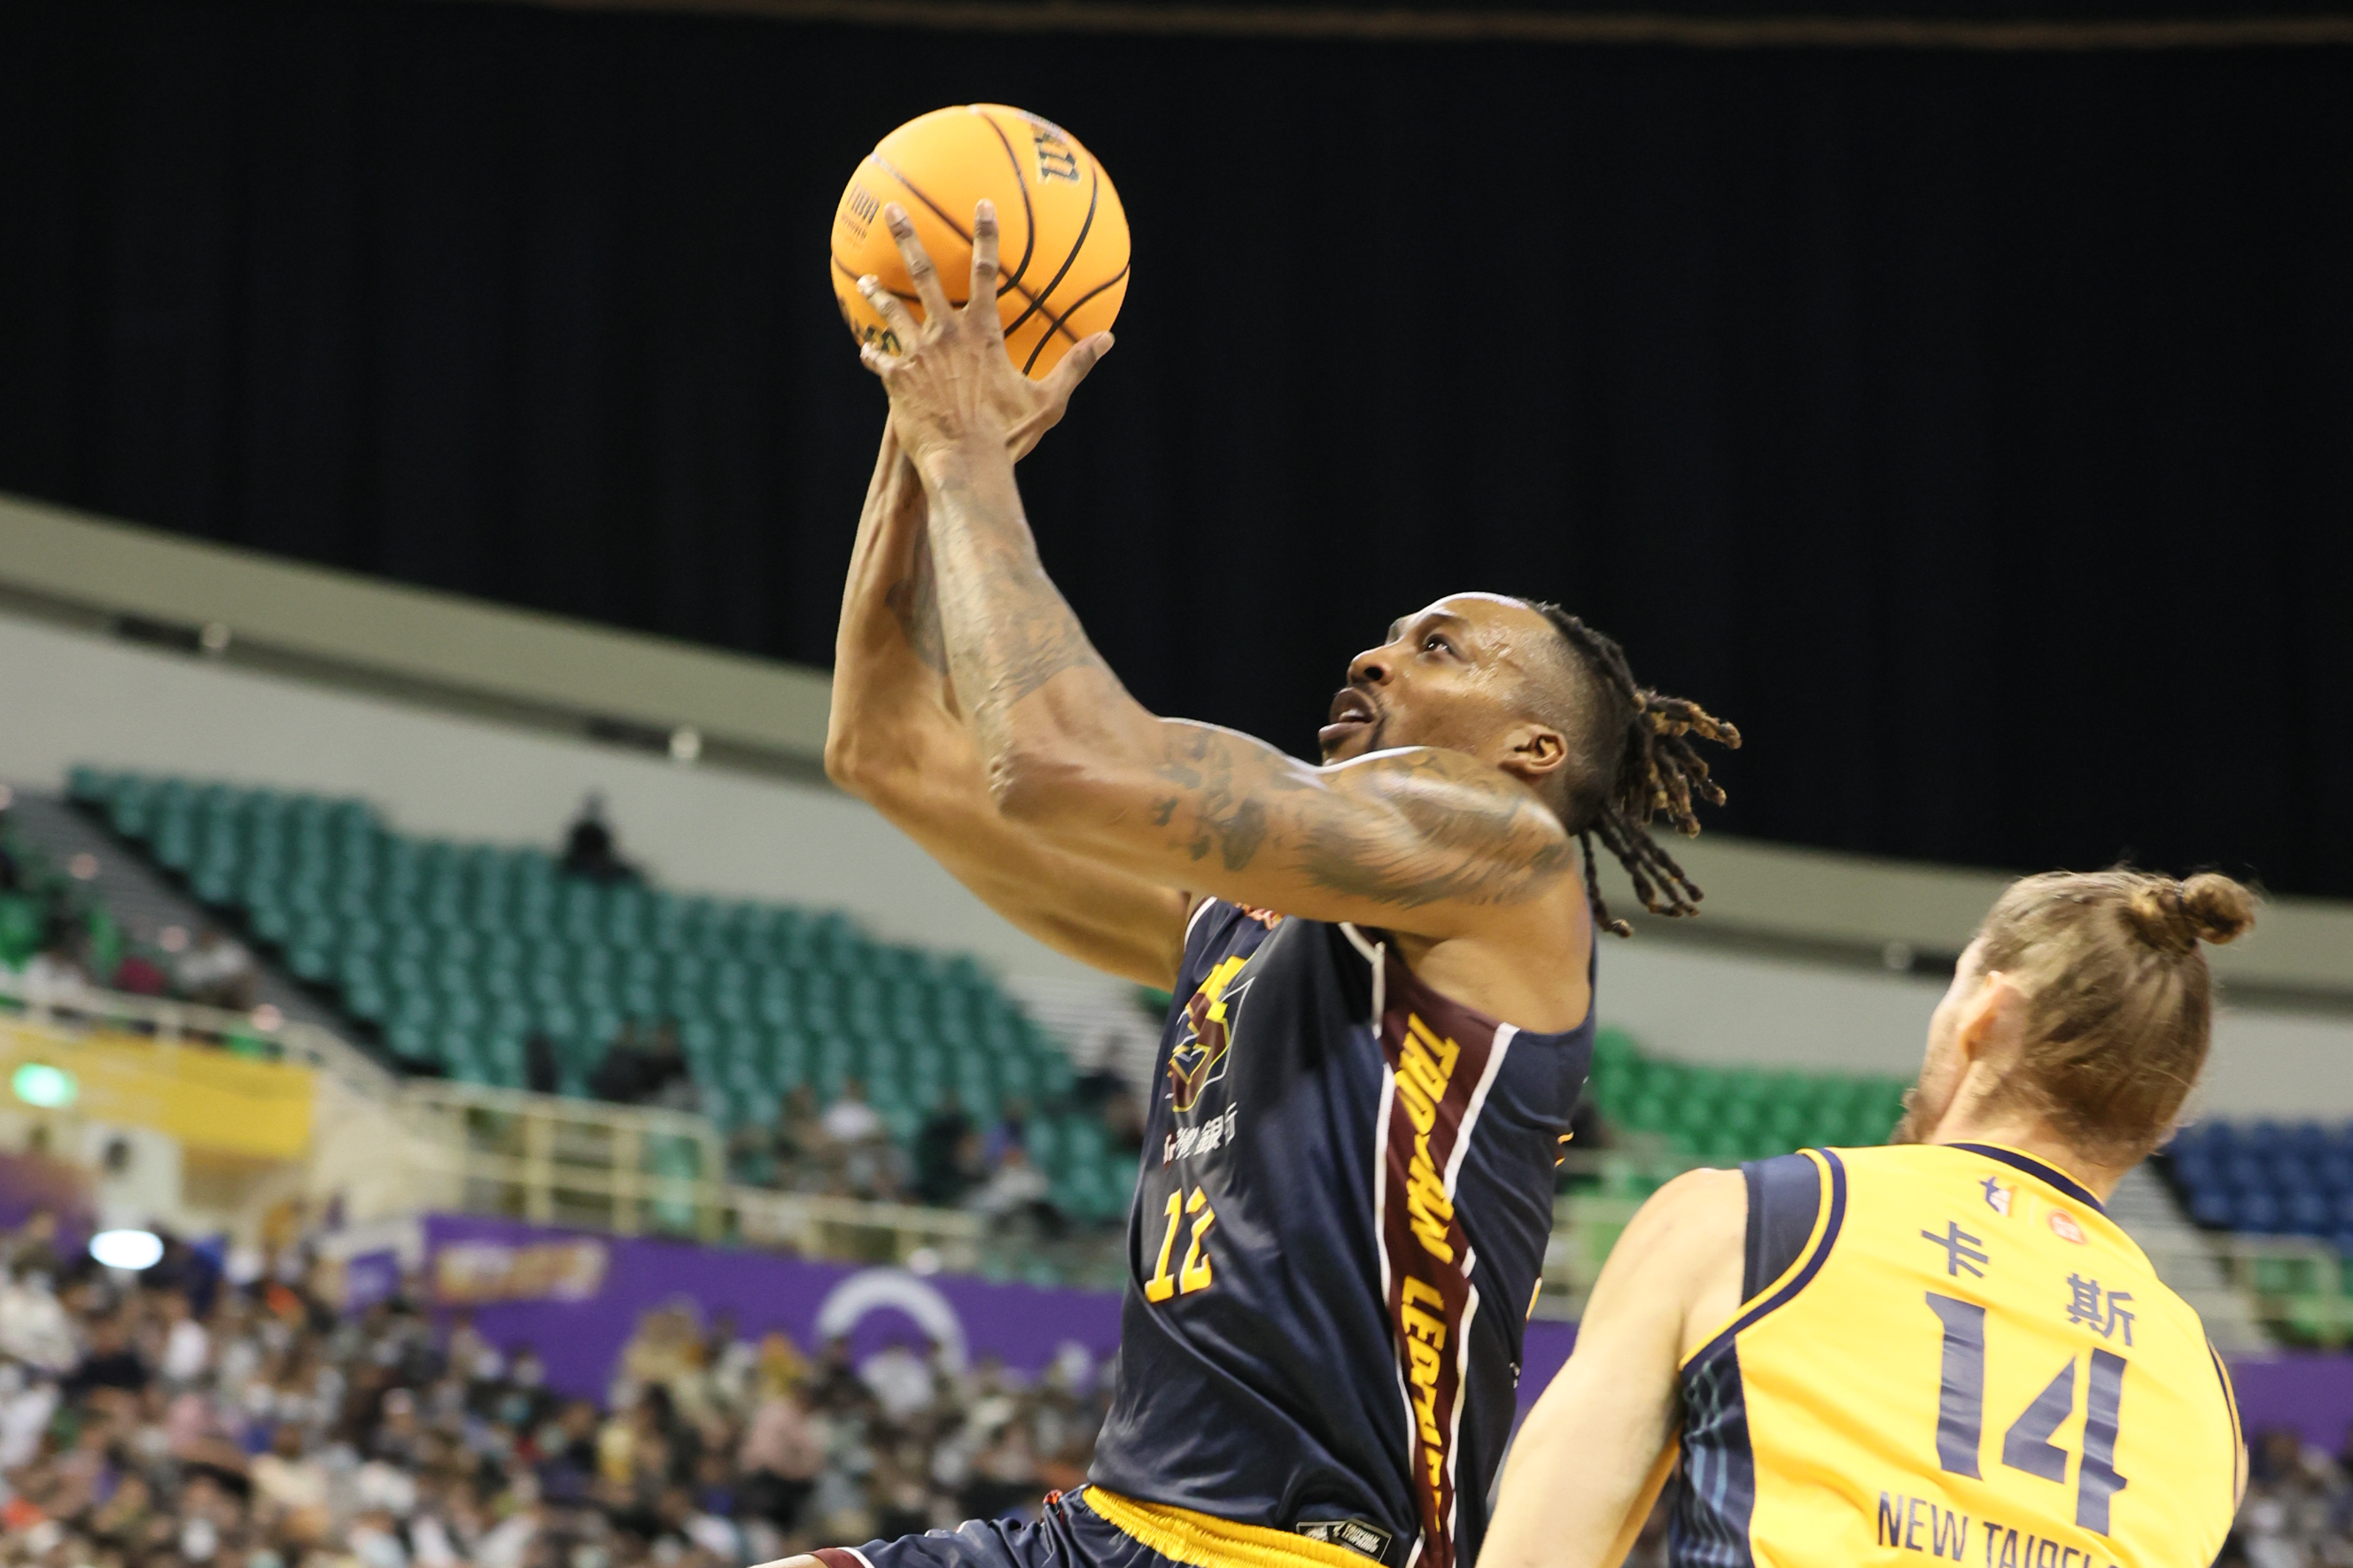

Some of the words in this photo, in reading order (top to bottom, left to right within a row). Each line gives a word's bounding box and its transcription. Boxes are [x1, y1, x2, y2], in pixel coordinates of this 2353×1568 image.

[1145, 1185, 1216, 1304] 12
[1921, 1221, 2137, 1347] 卡斯
[1924, 1291, 2128, 1538] 14
[1877, 1490, 1969, 1562] NEW
